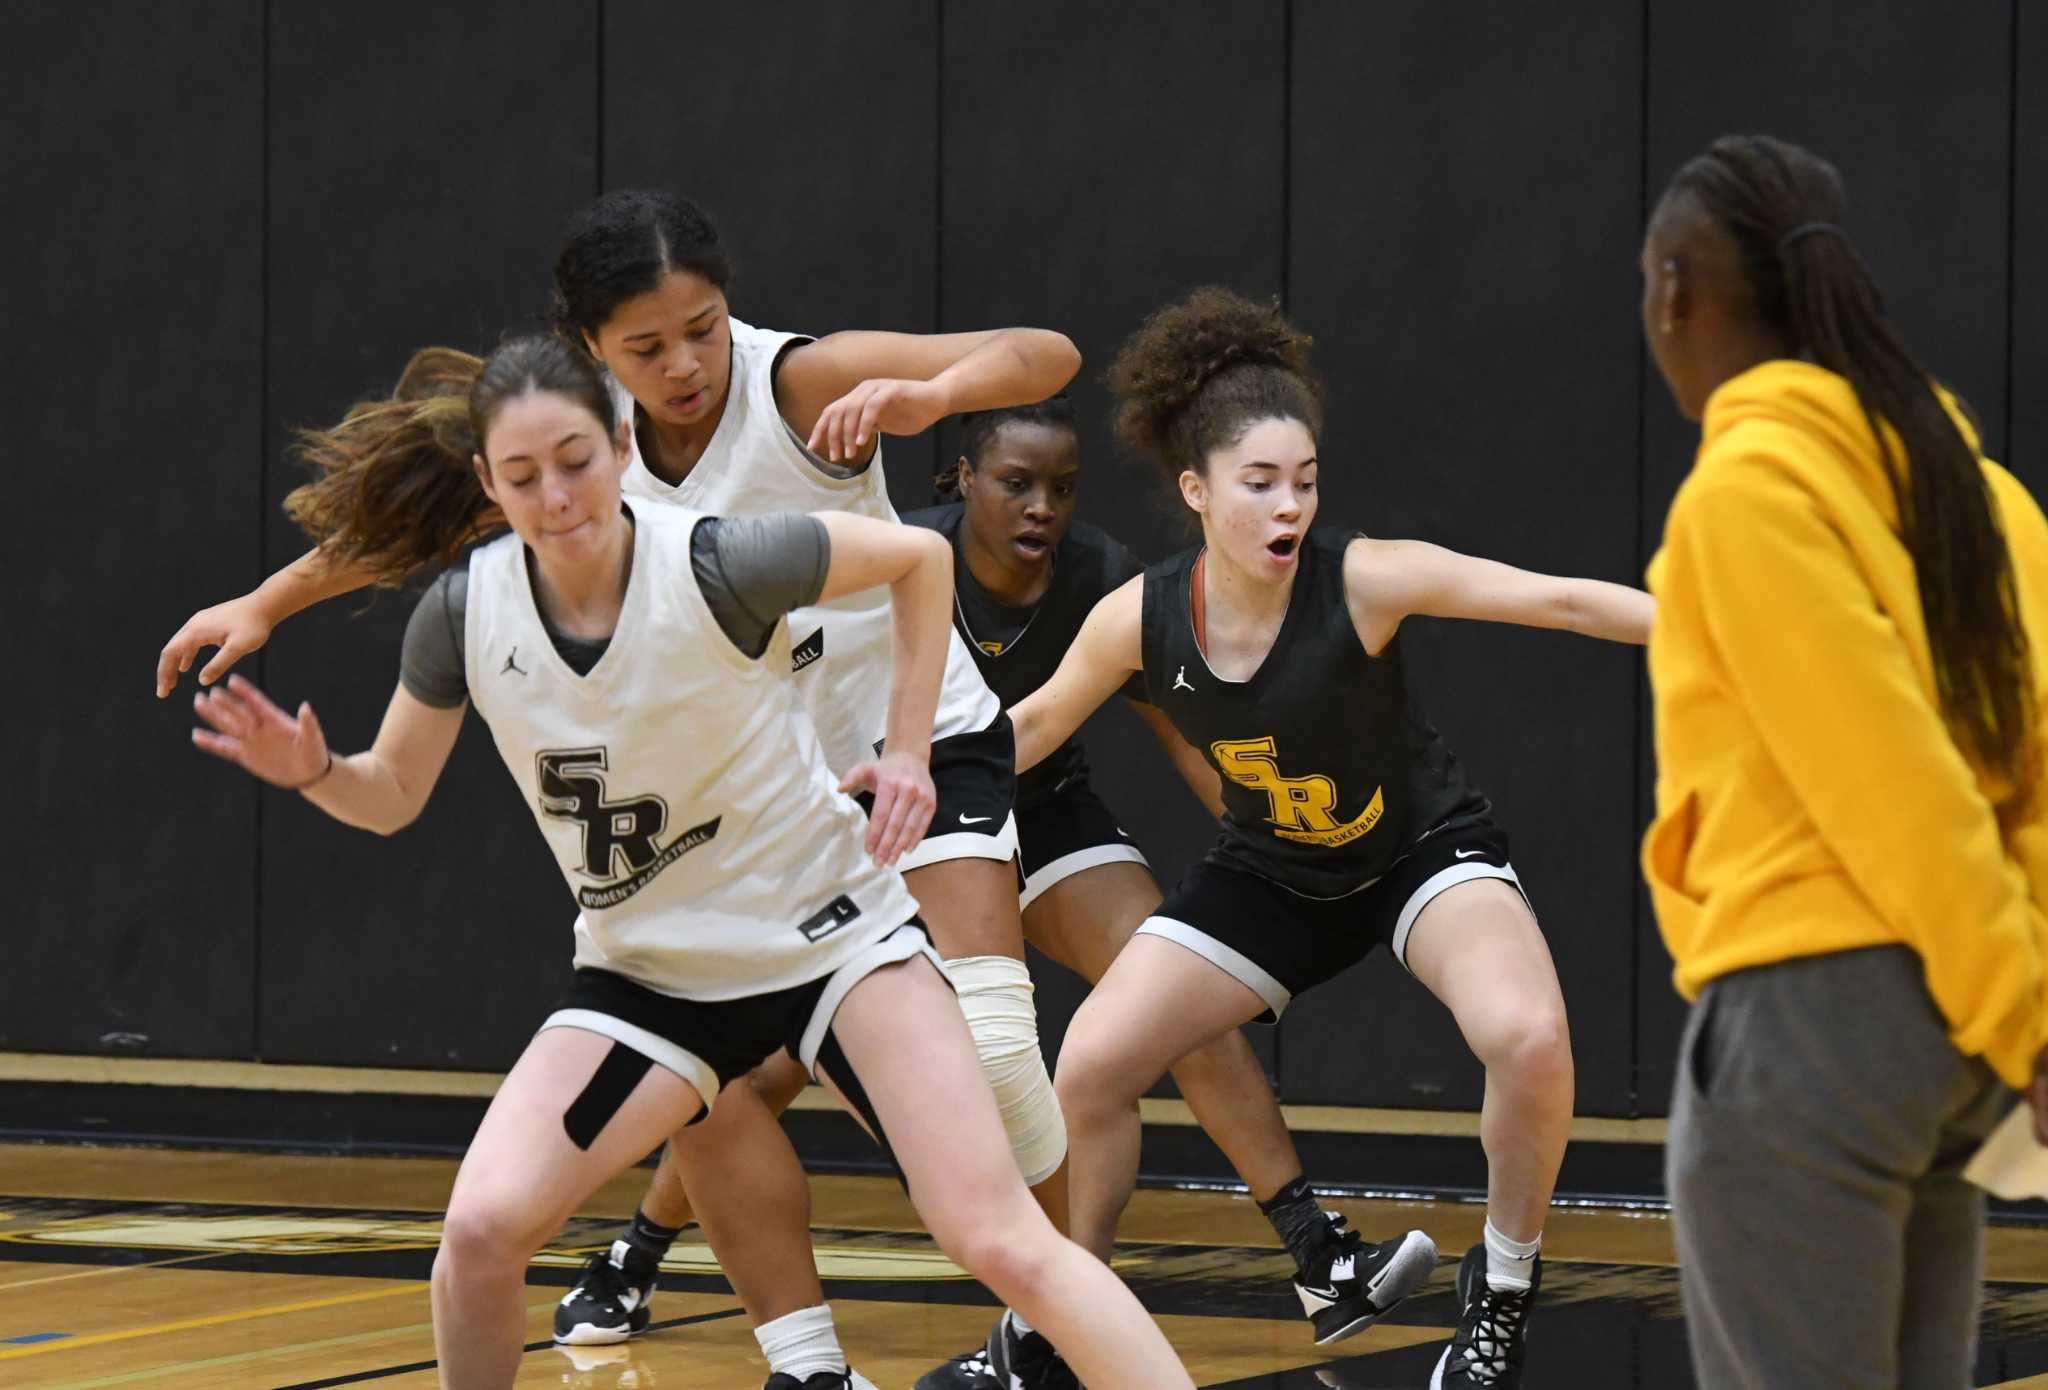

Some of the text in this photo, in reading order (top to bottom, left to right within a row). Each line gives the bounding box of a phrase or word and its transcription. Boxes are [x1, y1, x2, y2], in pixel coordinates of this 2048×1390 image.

[535, 746, 668, 882] SR
[1210, 736, 1340, 832] SR
[582, 831, 712, 907] WOMEN'S BASKETBALL
